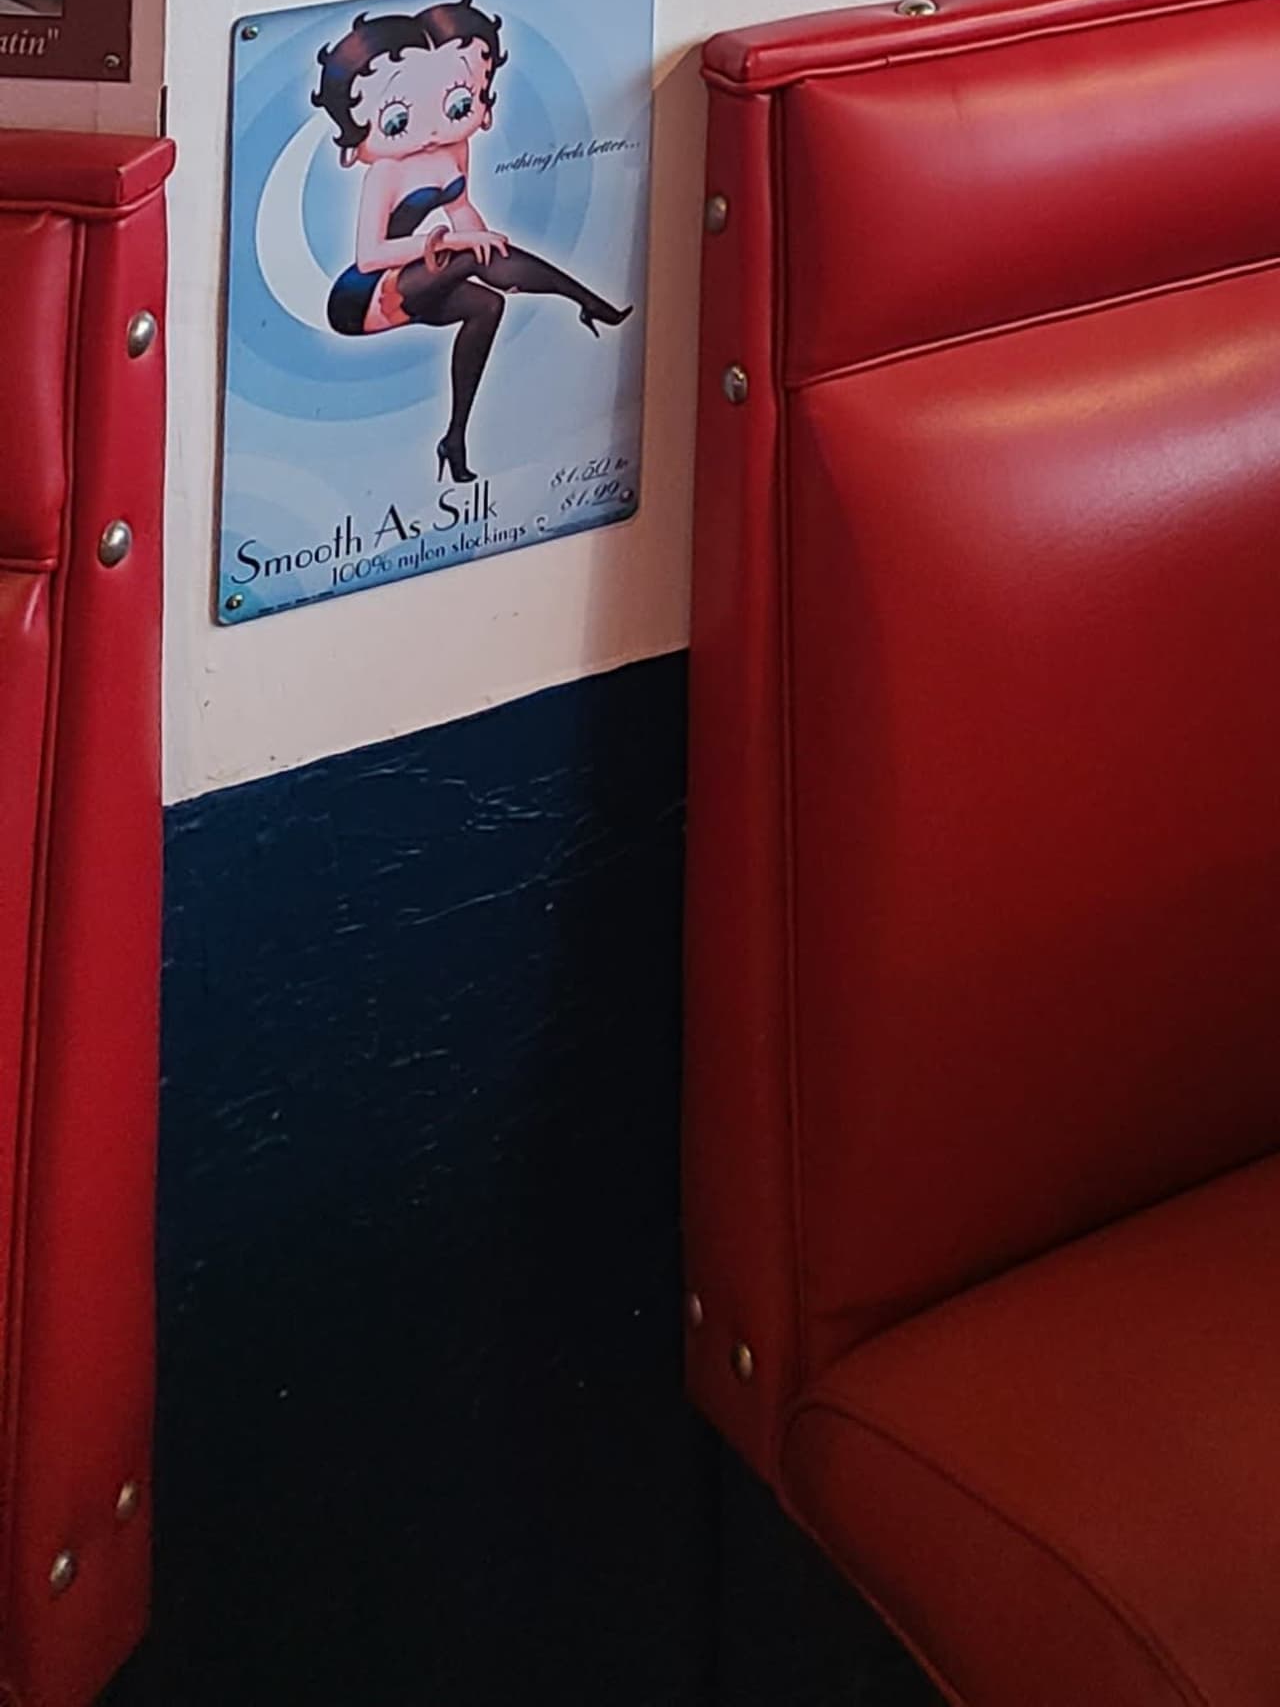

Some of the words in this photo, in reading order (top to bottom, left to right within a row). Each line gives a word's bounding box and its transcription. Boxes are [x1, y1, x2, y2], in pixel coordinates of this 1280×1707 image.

[230, 514, 362, 585] Smooth
[373, 503, 422, 548] As
[432, 479, 498, 532] Silk
[331, 551, 393, 587] 100%
